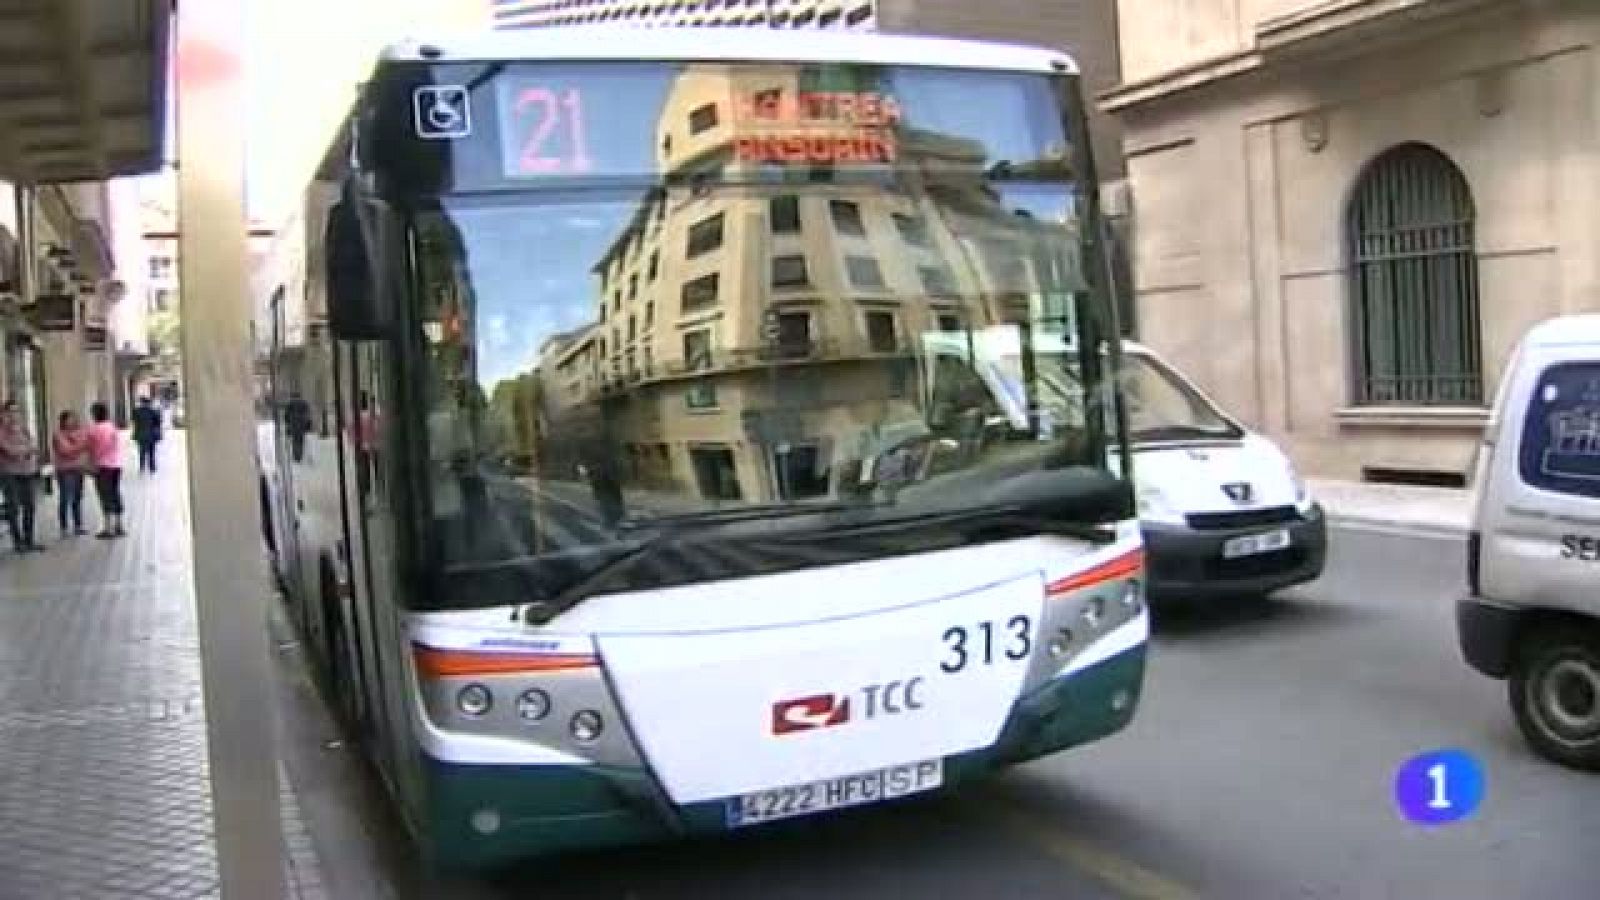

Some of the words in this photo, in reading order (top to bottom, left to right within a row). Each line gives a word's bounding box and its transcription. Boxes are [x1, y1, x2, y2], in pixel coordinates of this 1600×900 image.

[513, 87, 592, 173] 21
[1561, 533, 1600, 562] SE
[939, 613, 1031, 674] 313
[860, 676, 925, 720] TCC
